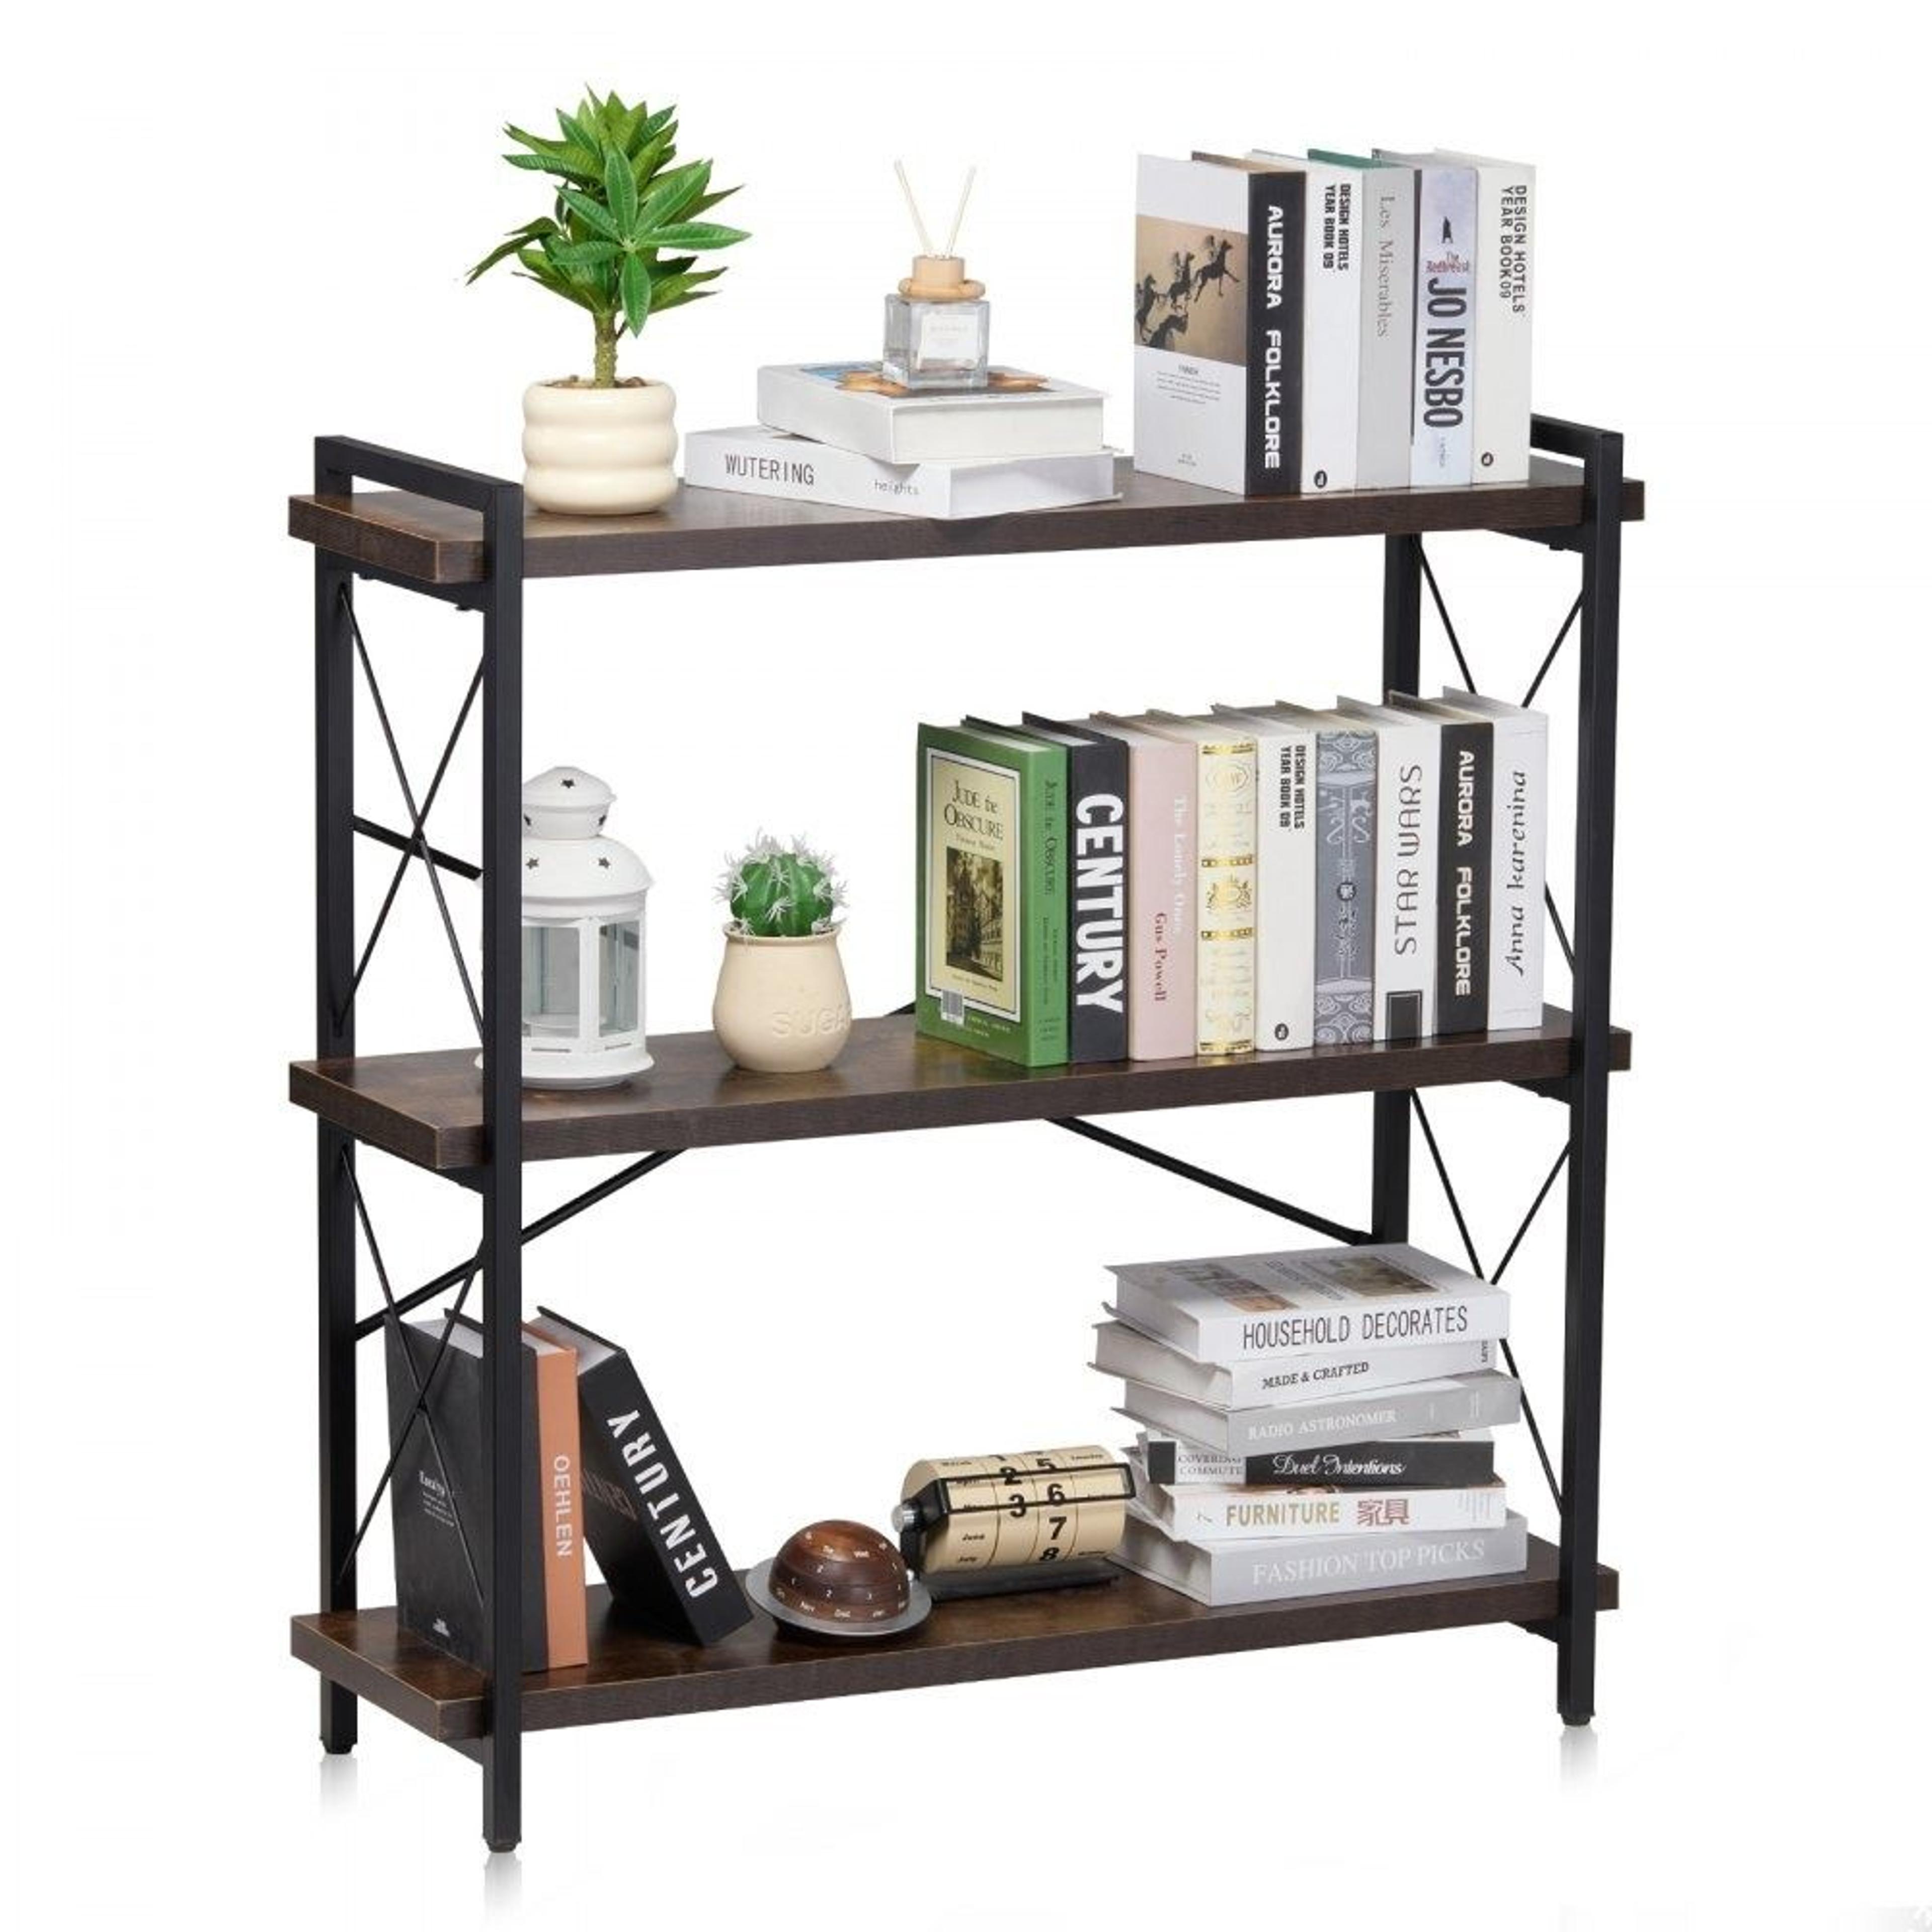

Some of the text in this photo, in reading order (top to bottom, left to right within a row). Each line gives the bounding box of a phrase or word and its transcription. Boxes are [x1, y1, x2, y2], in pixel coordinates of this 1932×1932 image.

[1325, 185, 1335, 213] YEAR
[1501, 186, 1514, 226] YEAR
[1324, 217, 1335, 249] BOOK
[1338, 184, 1350, 271] DESIGN HOTELS
[1378, 196, 1395, 337] Les Miserables
[1512, 186, 1527, 312] DESIGN HOTELS
[1264, 205, 1283, 469] AURORA FOLKLORE
[1423, 277, 1467, 427] JO NESBO
[725, 454, 920, 496] WUTERING heights
[1280, 746, 1292, 774] YEAR
[1280, 778, 1291, 808] BOOK
[1294, 745, 1306, 829] DESIGN HOTELS
[1395, 764, 1422, 955] STAR WARS
[1456, 751, 1475, 996] AURORA FOLKLORE
[1505, 771, 1526, 977] Anna karenina
[1076, 793, 1124, 1013] CENTURY
[1155, 912, 1167, 1002] Gus Powell
[772, 1004, 850, 1037] SUGA
[1243, 1306, 1468, 1350] HOUSEHOLD DECORATES
[1262, 1361, 1370, 1390] MADE & CRAFTED
[1248, 1409, 1397, 1441] RADIO ASTRONOMER
[1000, 1466, 1022, 1486] 2
[1179, 1466, 1244, 1476] COMMUTE
[553, 1456, 572, 1557] OEHLEN
[606, 1409, 719, 1599] CENTURY
[1009, 1493, 1027, 1518] 3
[1047, 1483, 1066, 1506] 6
[1226, 1501, 1341, 1527] FURNITURE
[1357, 1498, 1410, 1526] 家具
[1049, 1516, 1067, 1540] 7
[1252, 1539, 1485, 1585] FASHION TOP PICKS
